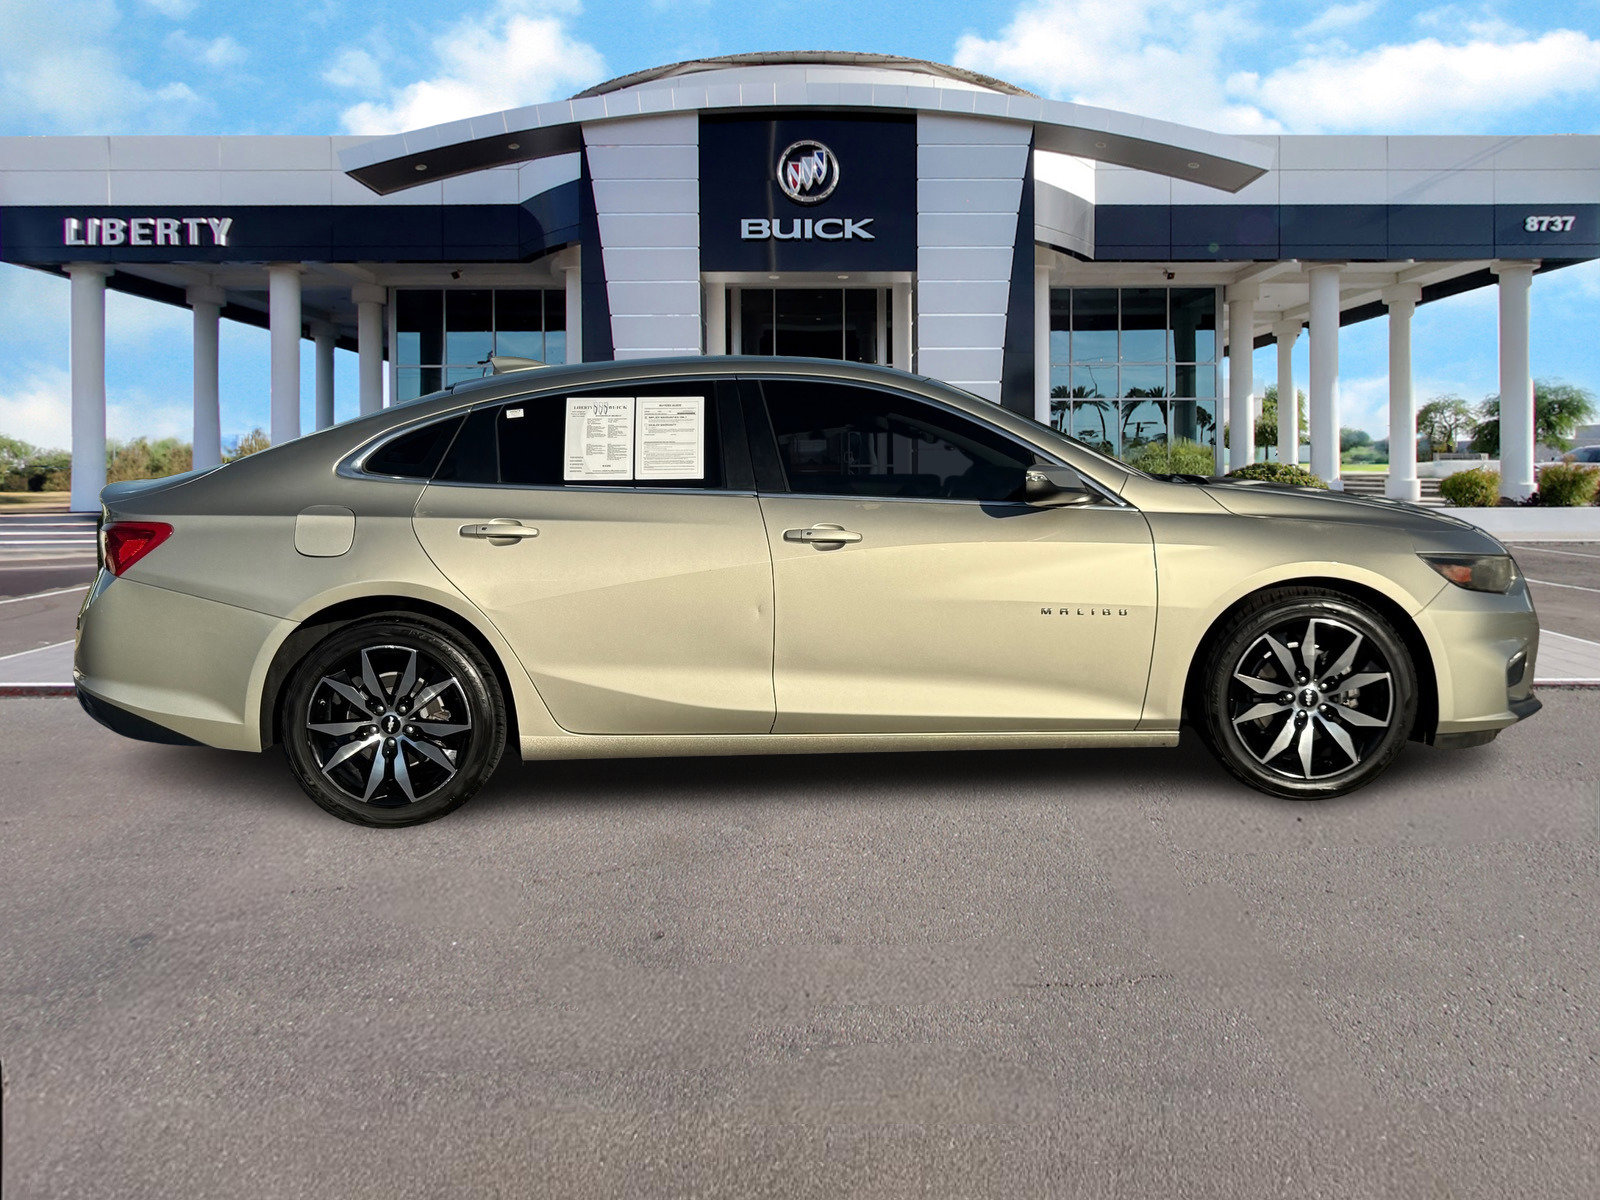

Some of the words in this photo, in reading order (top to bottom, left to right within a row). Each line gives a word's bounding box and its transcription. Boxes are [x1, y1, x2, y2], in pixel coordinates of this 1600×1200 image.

[64, 217, 233, 246] LIBERTY
[740, 218, 876, 240] BUICK
[1524, 215, 1576, 232] 8737
[1040, 607, 1128, 616] MALIBU
